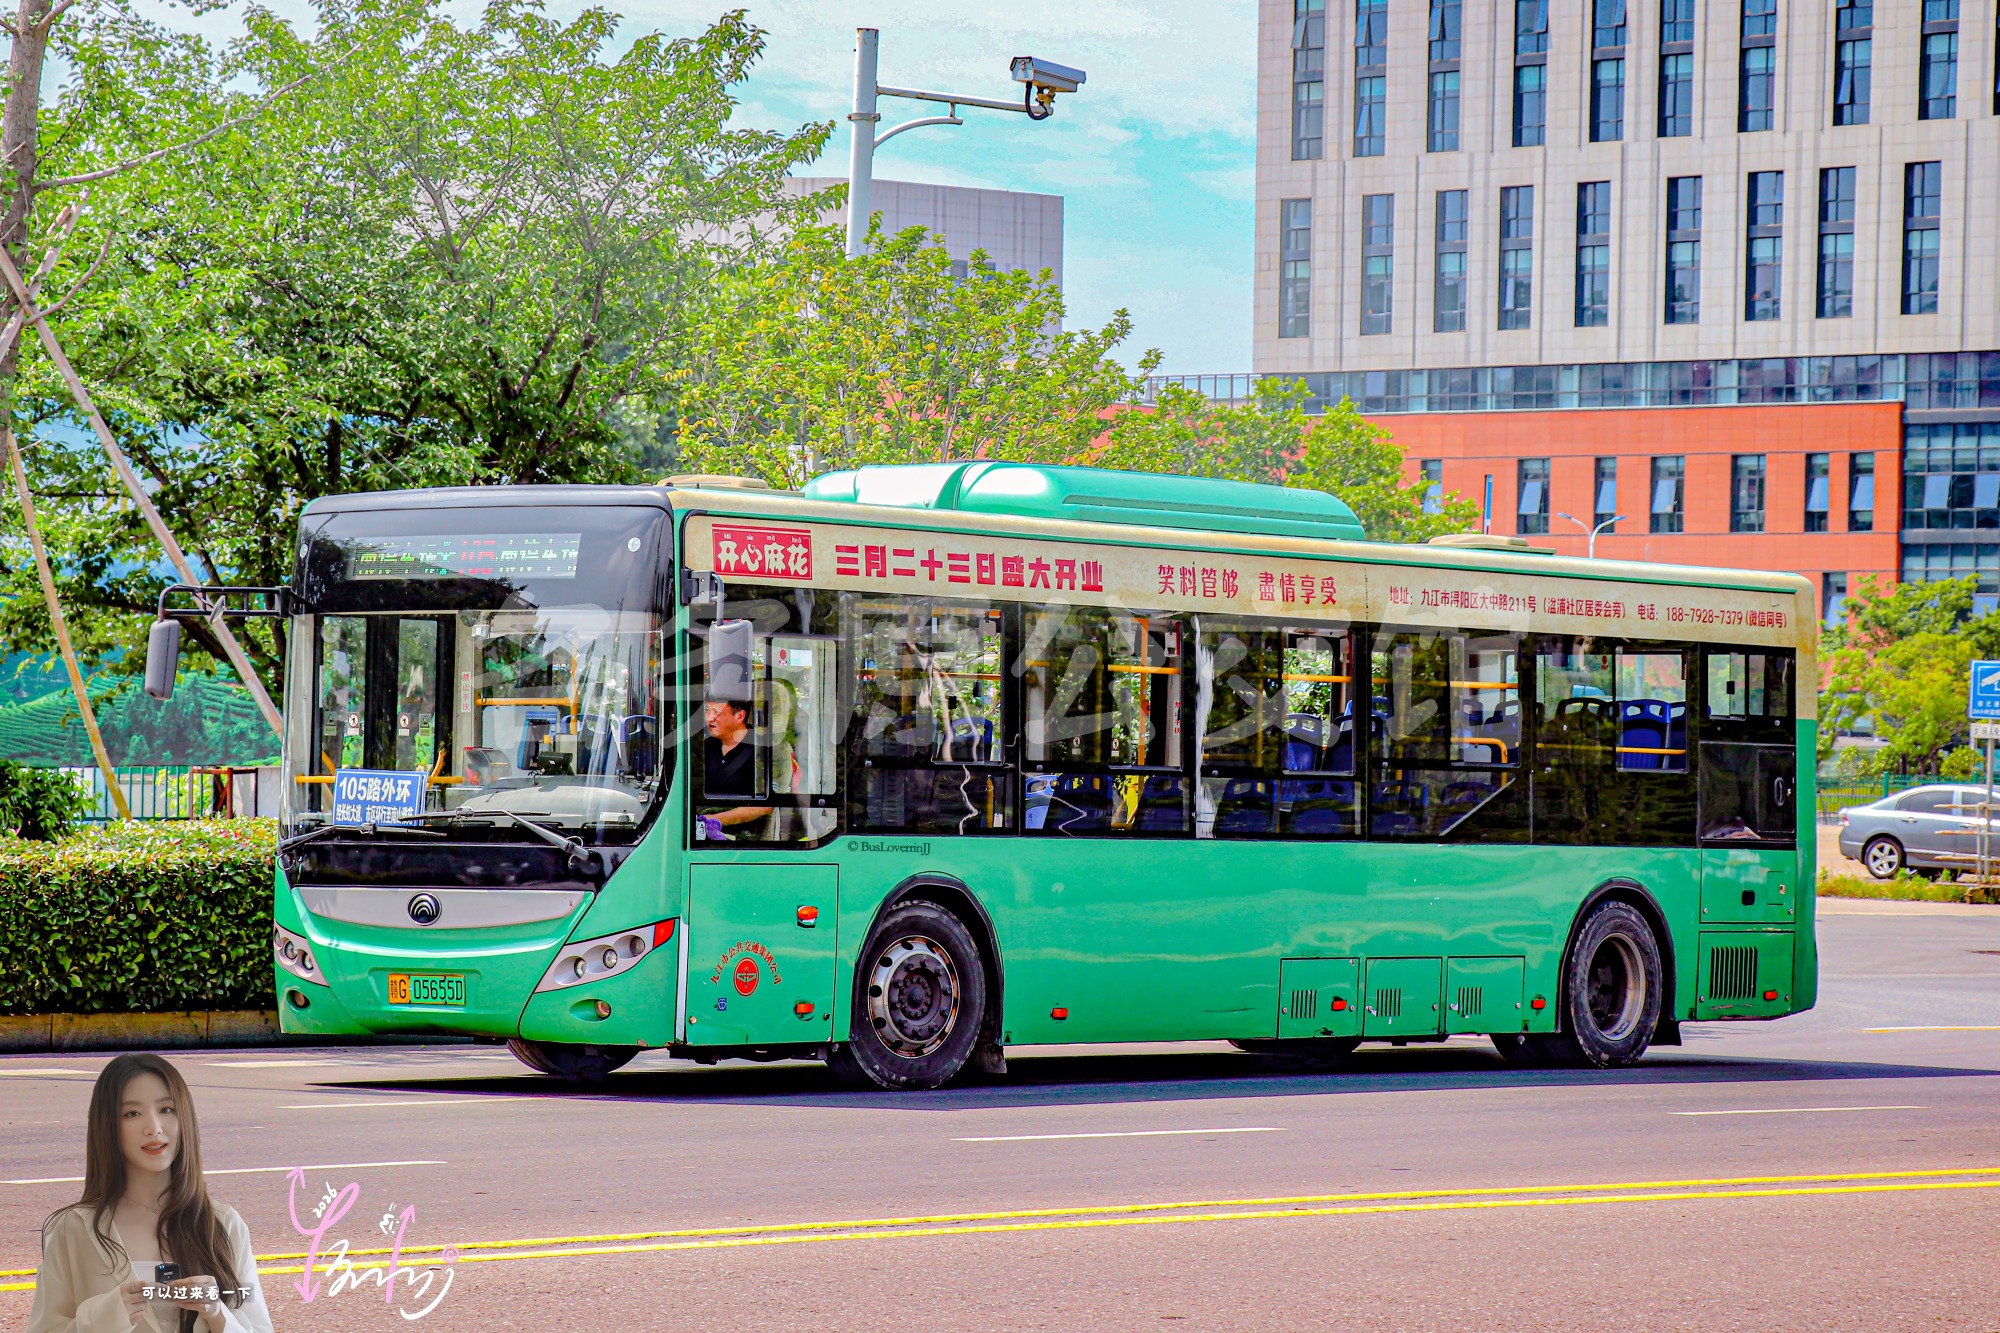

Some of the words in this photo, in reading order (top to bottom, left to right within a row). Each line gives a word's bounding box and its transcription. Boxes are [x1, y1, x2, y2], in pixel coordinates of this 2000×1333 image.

[718, 540, 809, 576] 开心麻花
[835, 543, 1104, 593] 三月二十三日盛大开业
[1157, 563, 1239, 600] 笑料管够
[1258, 570, 1338, 606] 盡情享受
[339, 776, 412, 804] 105路外环
